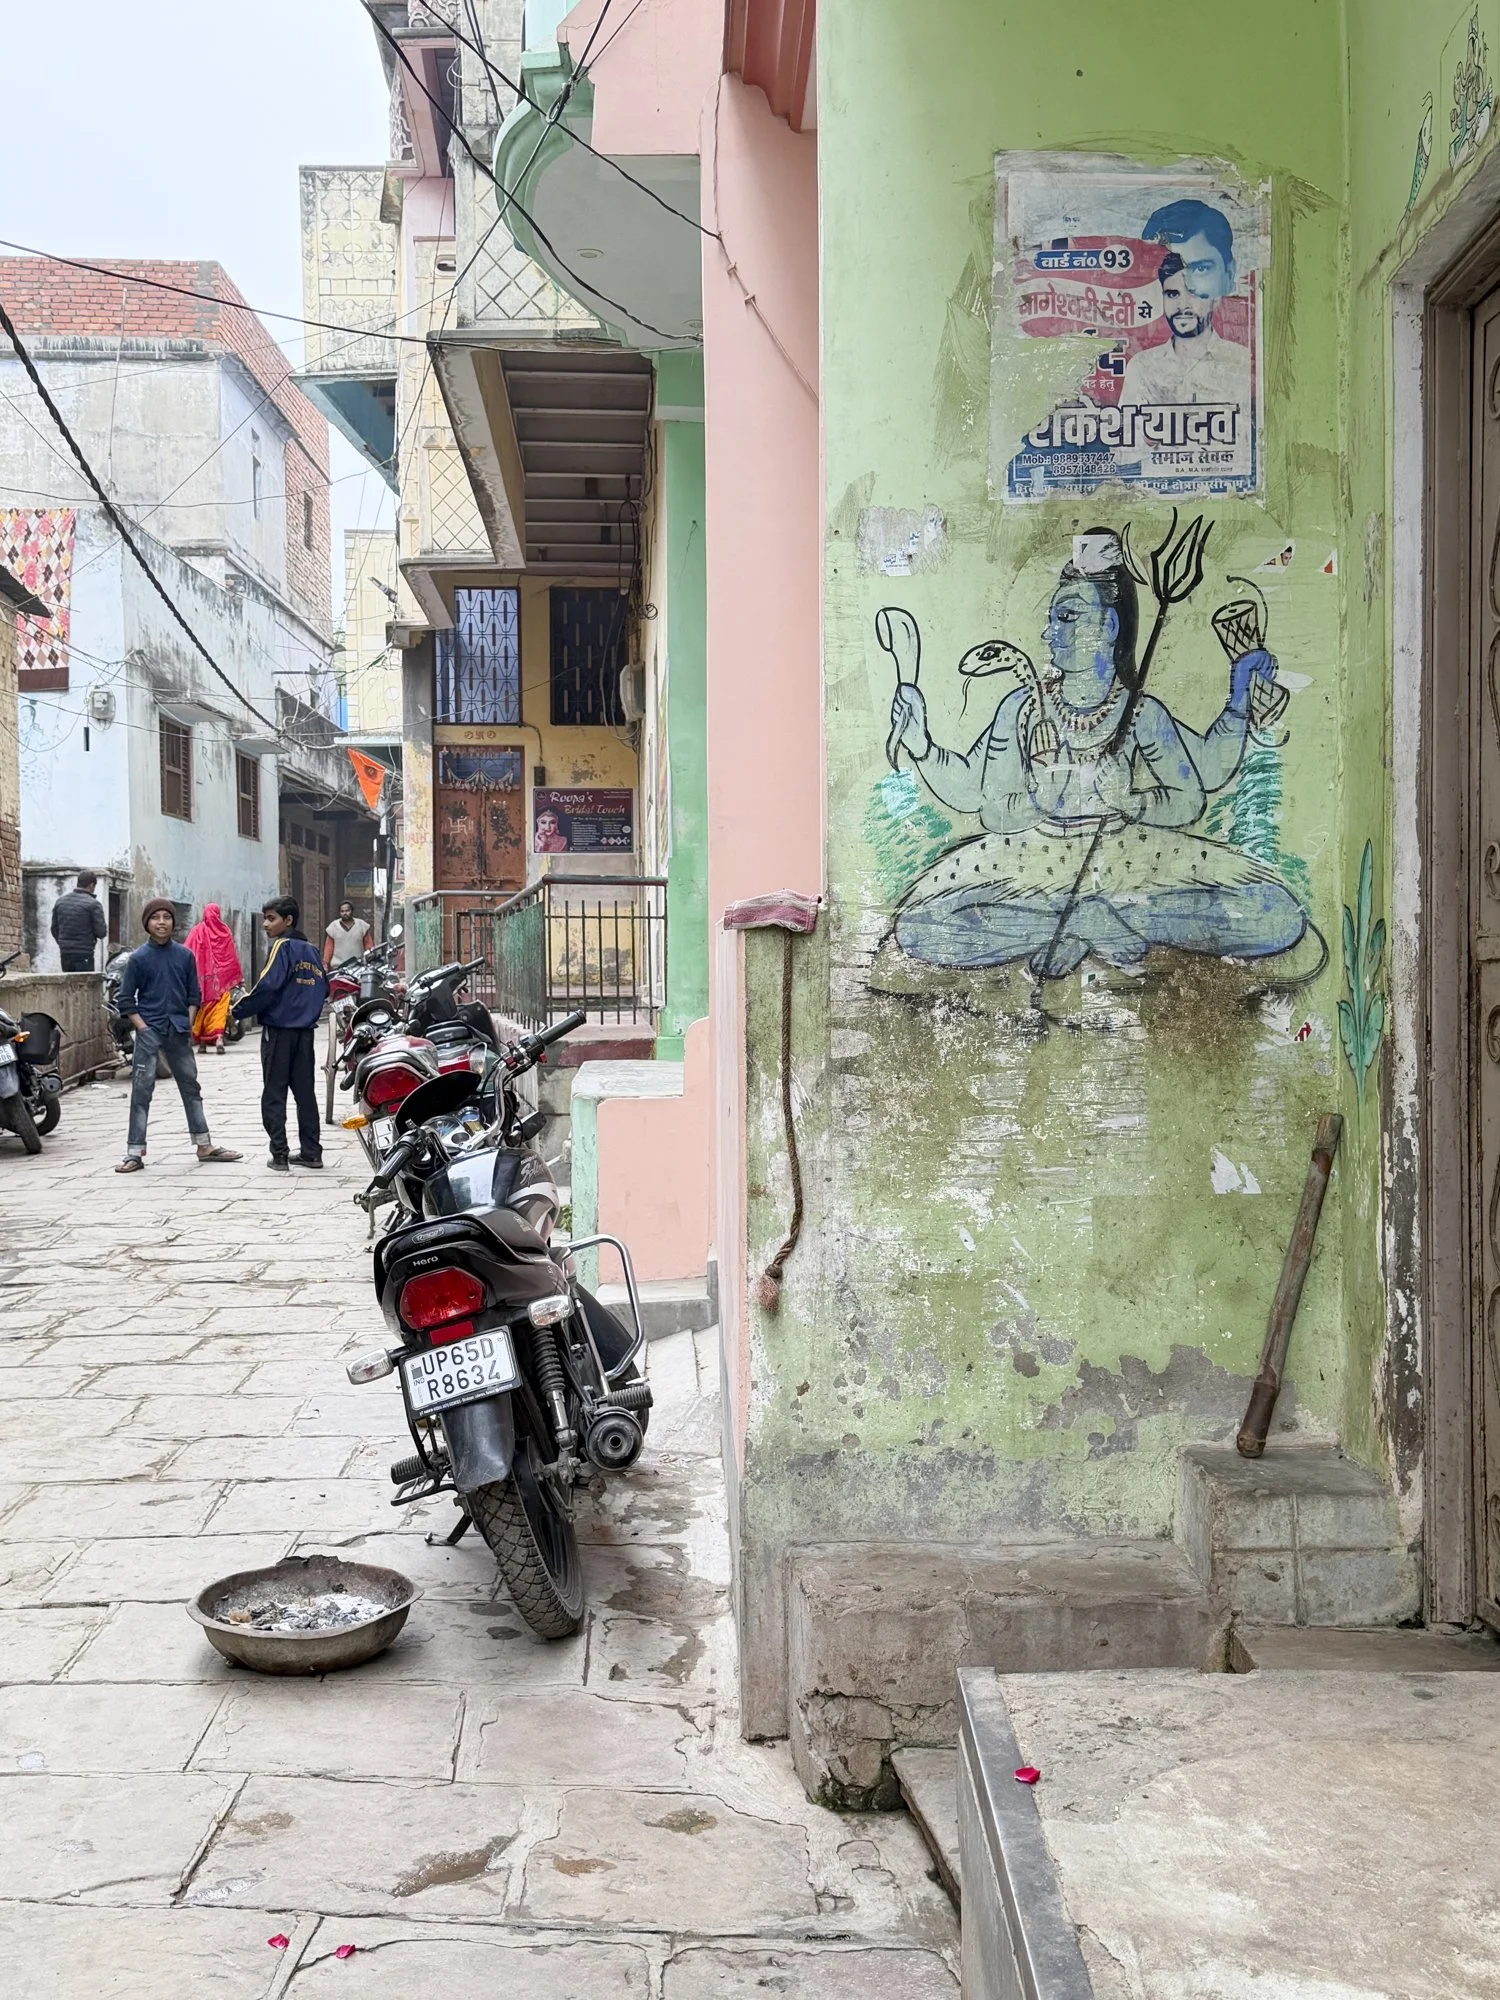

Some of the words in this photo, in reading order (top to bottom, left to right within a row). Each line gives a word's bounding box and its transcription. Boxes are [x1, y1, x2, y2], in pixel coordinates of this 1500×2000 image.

[1041, 252, 1070, 268] वार्ड
[1103, 249, 1131, 268] 93
[1101, 291, 1136, 326] देवी
[1138, 300, 1153, 318] से
[1099, 376, 1115, 391] हेतु
[1139, 402, 1240, 446] यादव
[1151, 451, 1195, 465] समाज
[1197, 447, 1235, 464] सेवक
[563, 804, 594, 815] Bridal
[597, 804, 625, 815] Touch
[412, 1256, 439, 1267] Hero
[422, 1337, 495, 1375] UP65D
[427, 1360, 501, 1401] R8634
